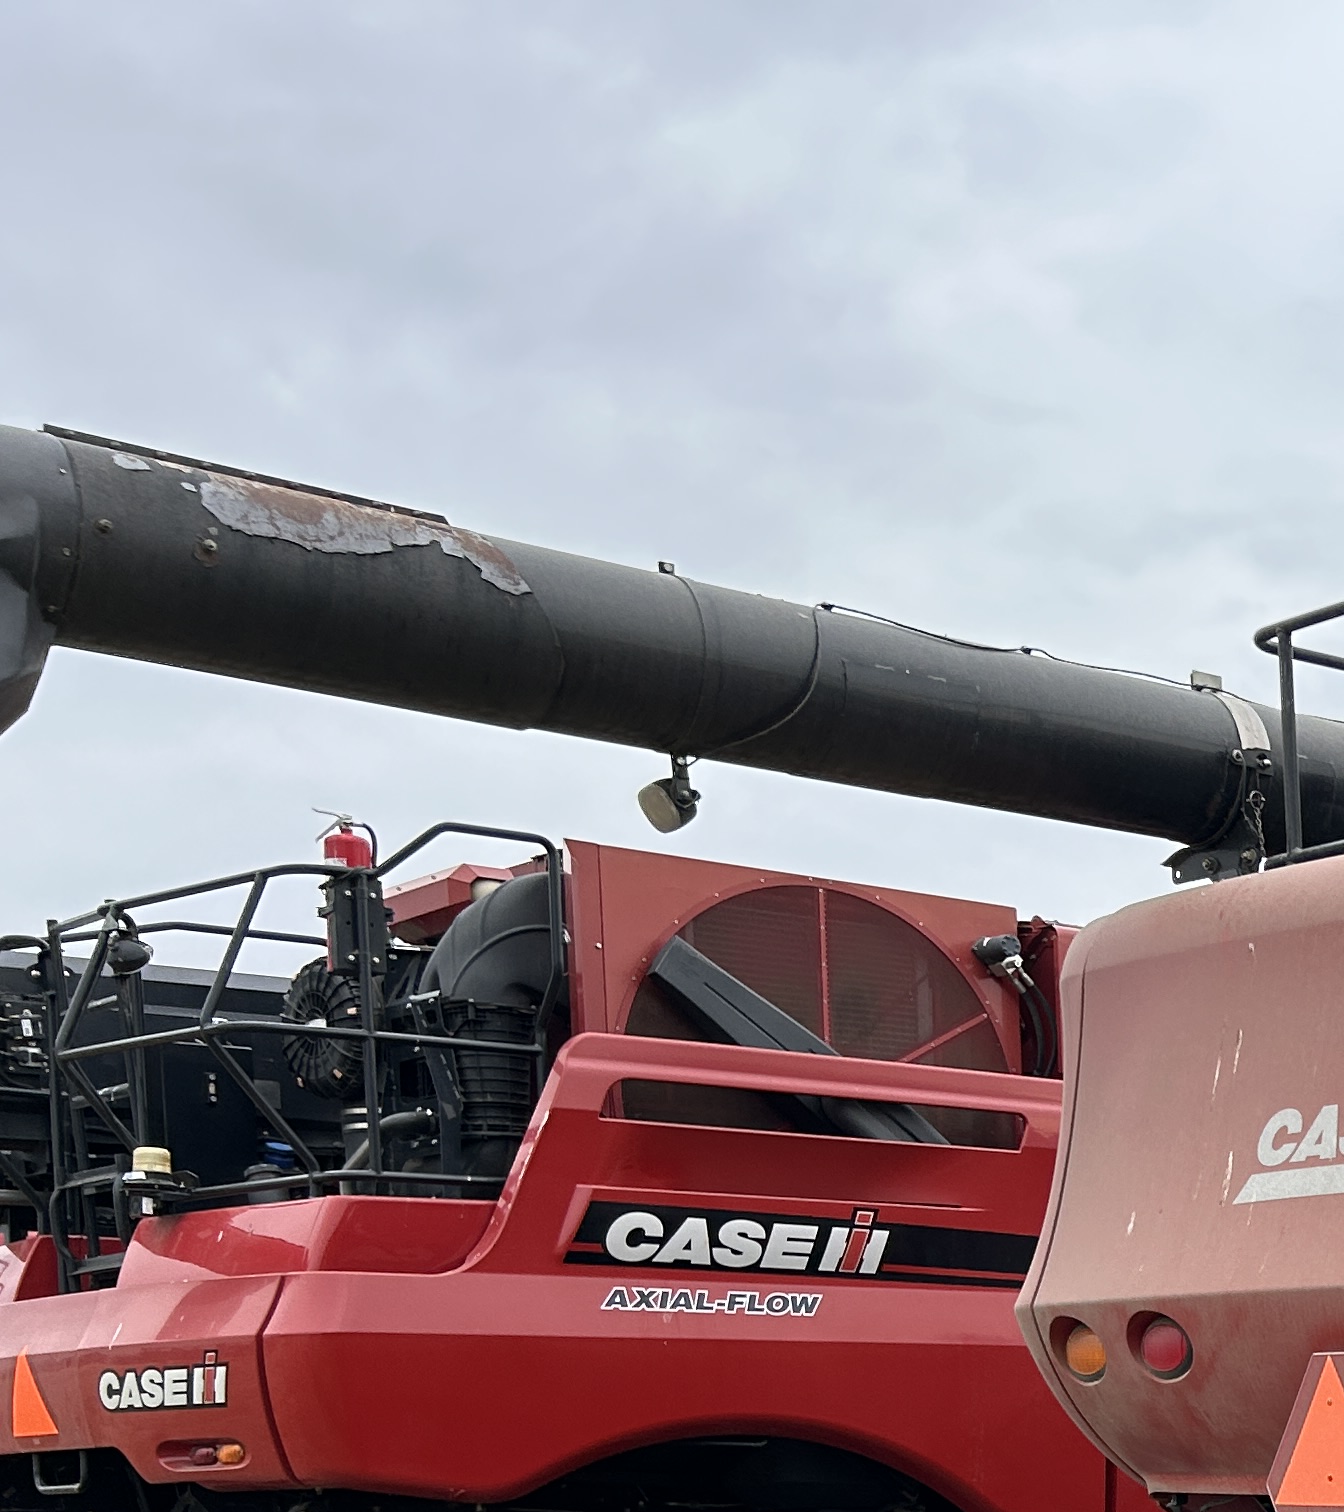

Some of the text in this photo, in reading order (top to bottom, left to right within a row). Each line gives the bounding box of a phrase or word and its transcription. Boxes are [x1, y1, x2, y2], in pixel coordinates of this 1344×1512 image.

[605, 1211, 819, 1272] CASE
[601, 1287, 823, 1316] AXIAL-FLOW
[99, 1368, 188, 1410] CASE
